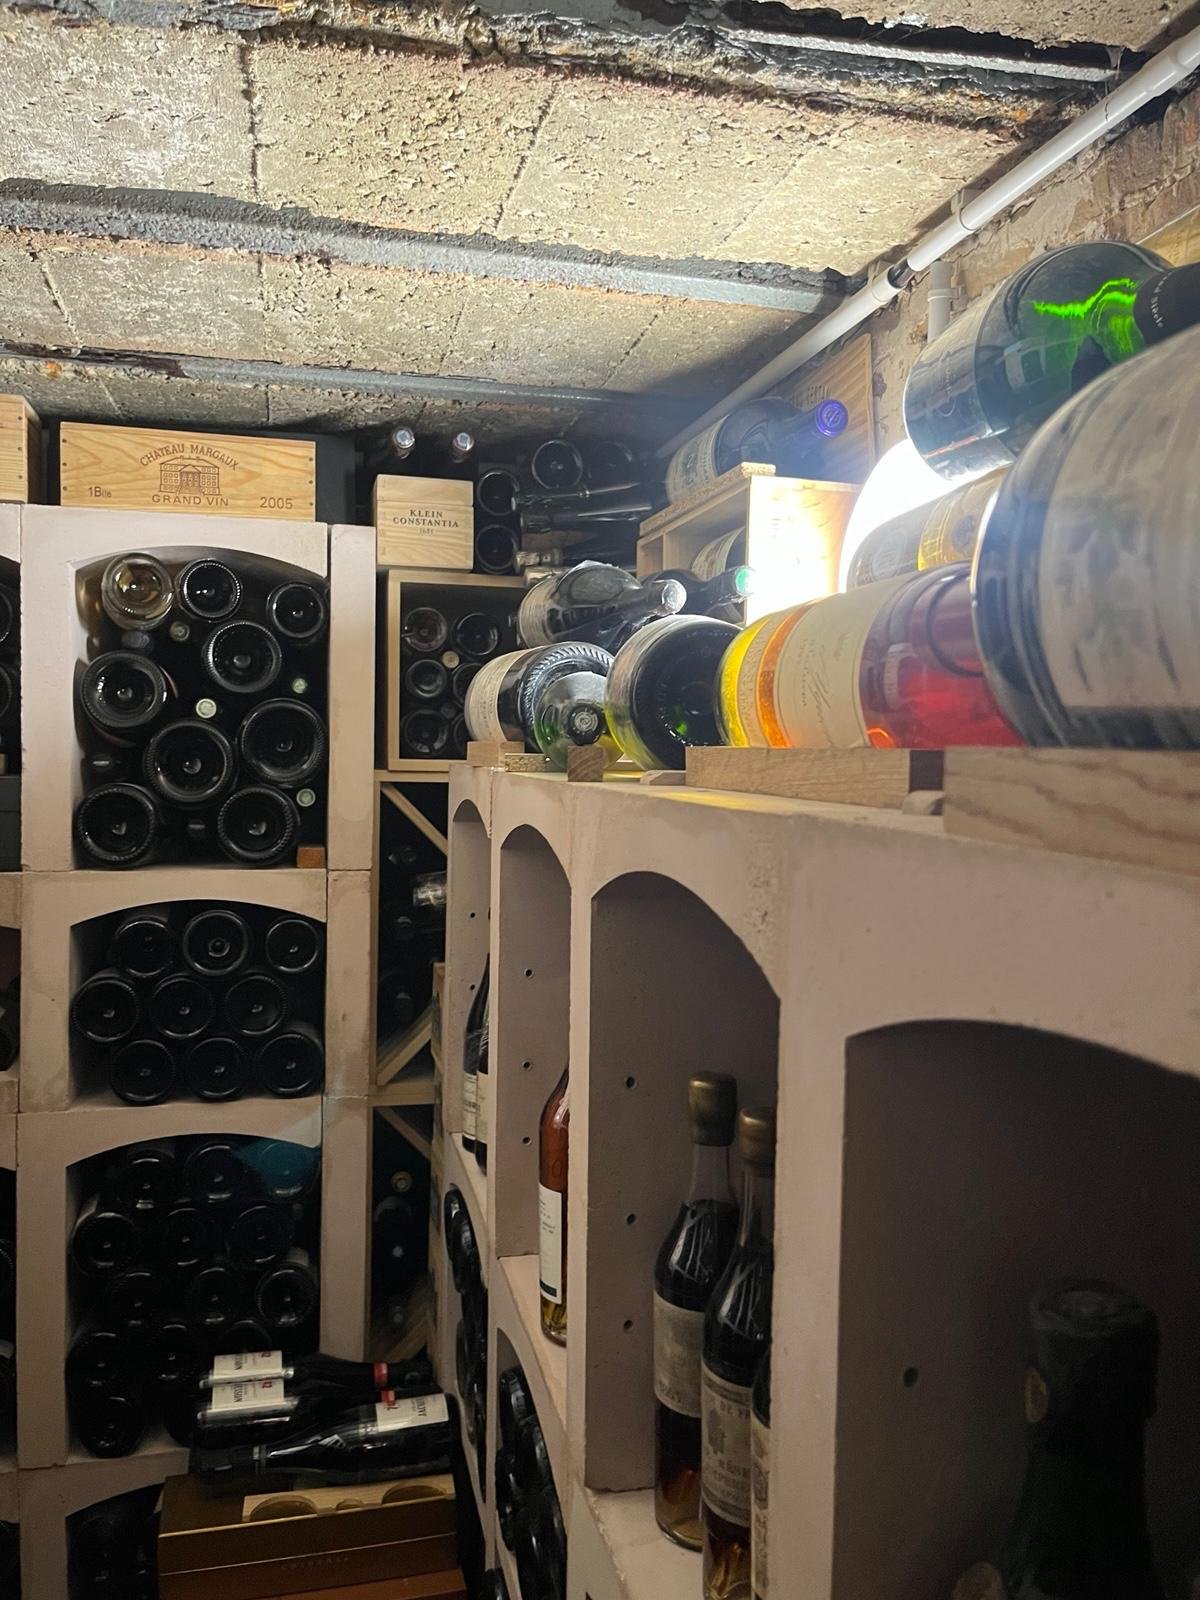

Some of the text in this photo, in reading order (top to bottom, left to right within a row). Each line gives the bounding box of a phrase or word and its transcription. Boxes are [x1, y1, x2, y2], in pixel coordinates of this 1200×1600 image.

[140, 443, 239, 471] CHATEAU MARGAUX
[151, 494, 229, 507] GRAND VIN
[259, 496, 293, 509] 2005
[409, 509, 443, 518] KLEIN
[392, 516, 459, 528] CONSTANTIA
